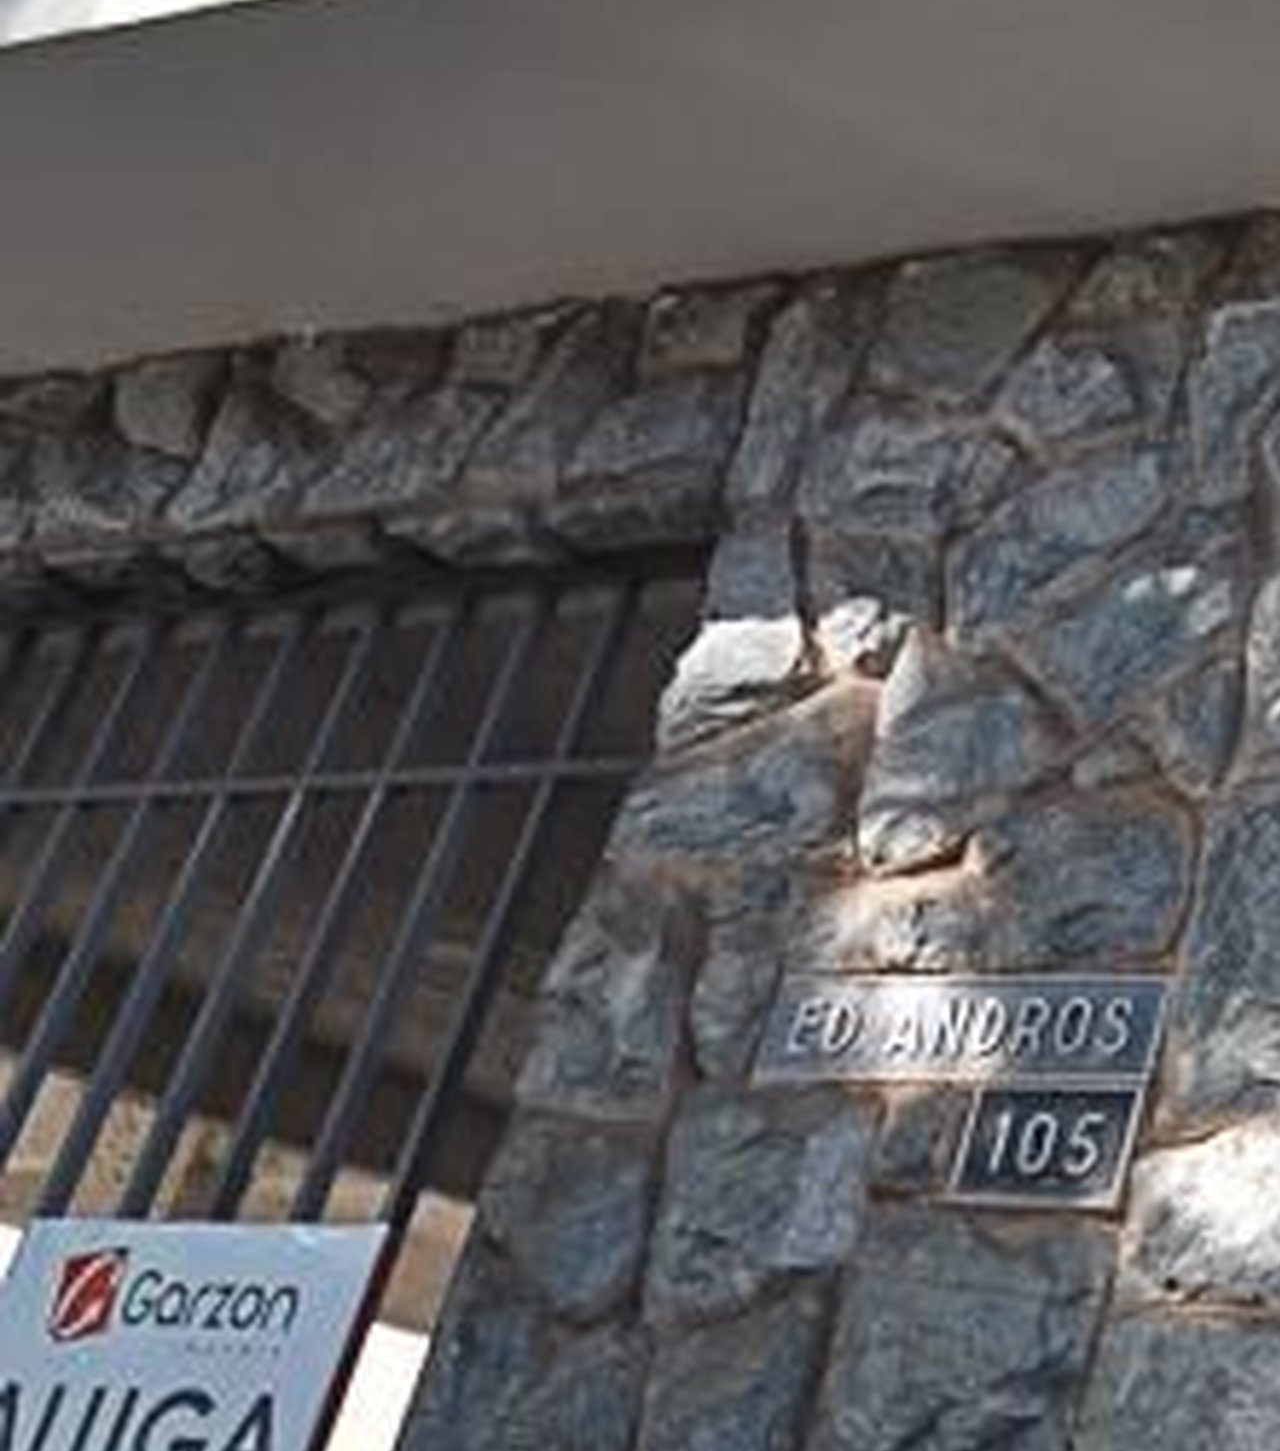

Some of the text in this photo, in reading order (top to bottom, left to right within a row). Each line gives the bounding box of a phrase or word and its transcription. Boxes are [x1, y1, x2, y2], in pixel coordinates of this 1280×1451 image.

[885, 997, 1132, 1060] ANDROS
[988, 1112, 1104, 1176] 105
[122, 1268, 298, 1336] Garzon
